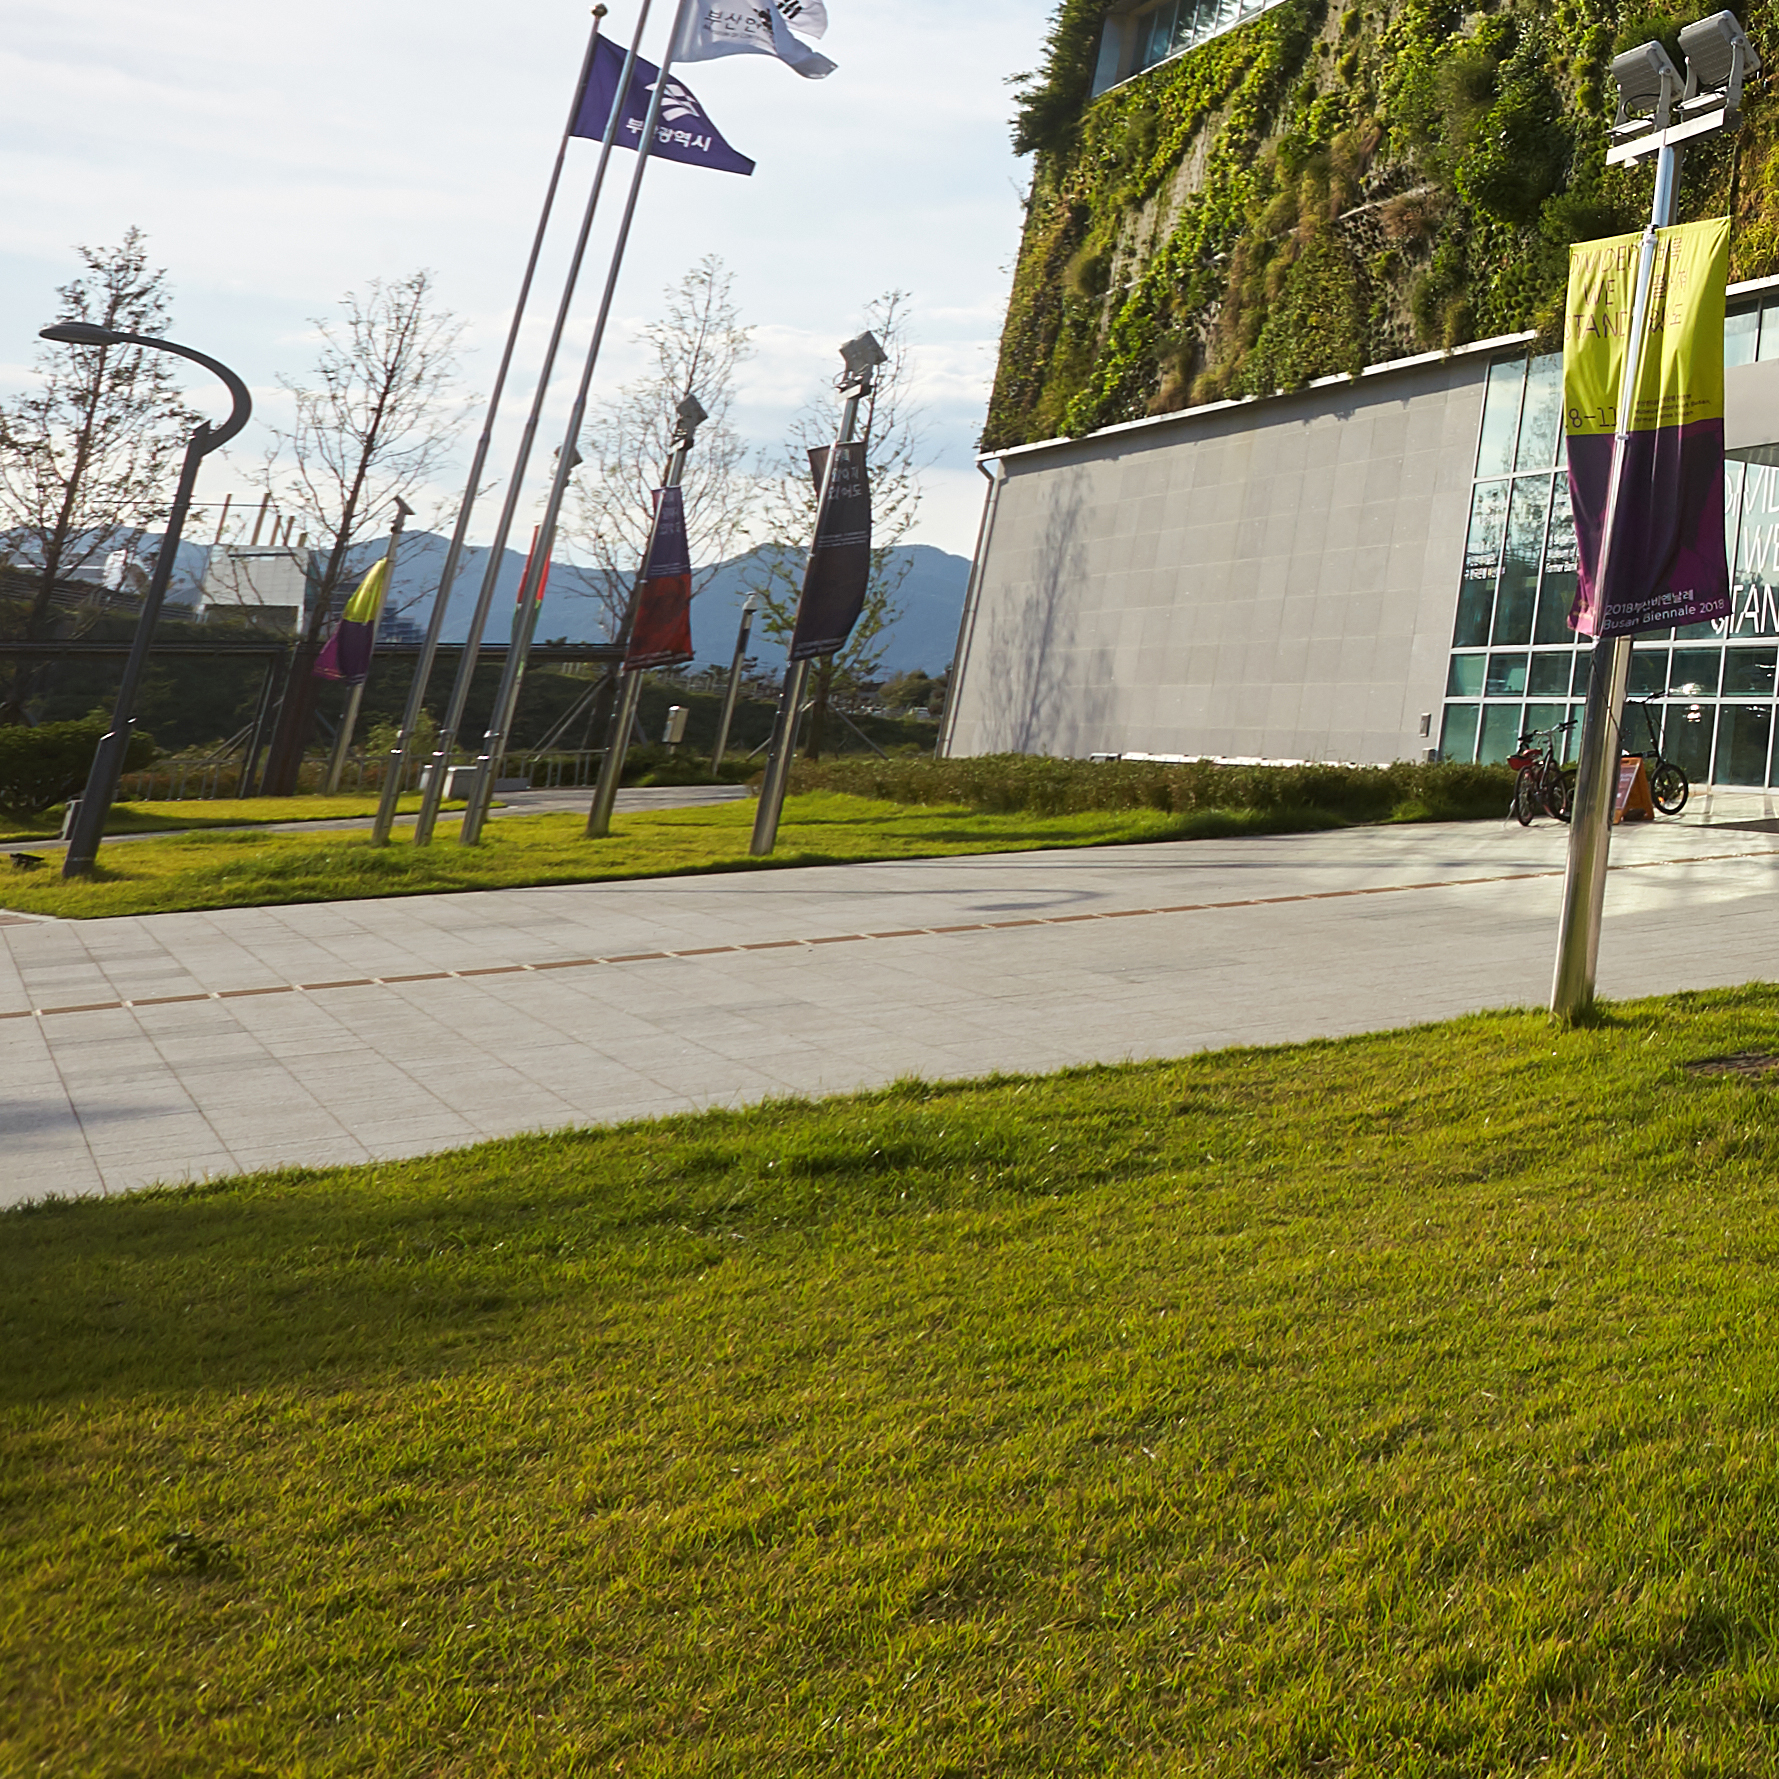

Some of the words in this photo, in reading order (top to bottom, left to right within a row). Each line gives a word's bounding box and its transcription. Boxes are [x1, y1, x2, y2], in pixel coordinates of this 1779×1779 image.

[625, 117, 712, 152] 부광역시
[1583, 278, 1616, 307] WE
[1603, 616, 1640, 631] Busan
[1642, 603, 1697, 624] Biennale
[1699, 598, 1726, 615] 2018
